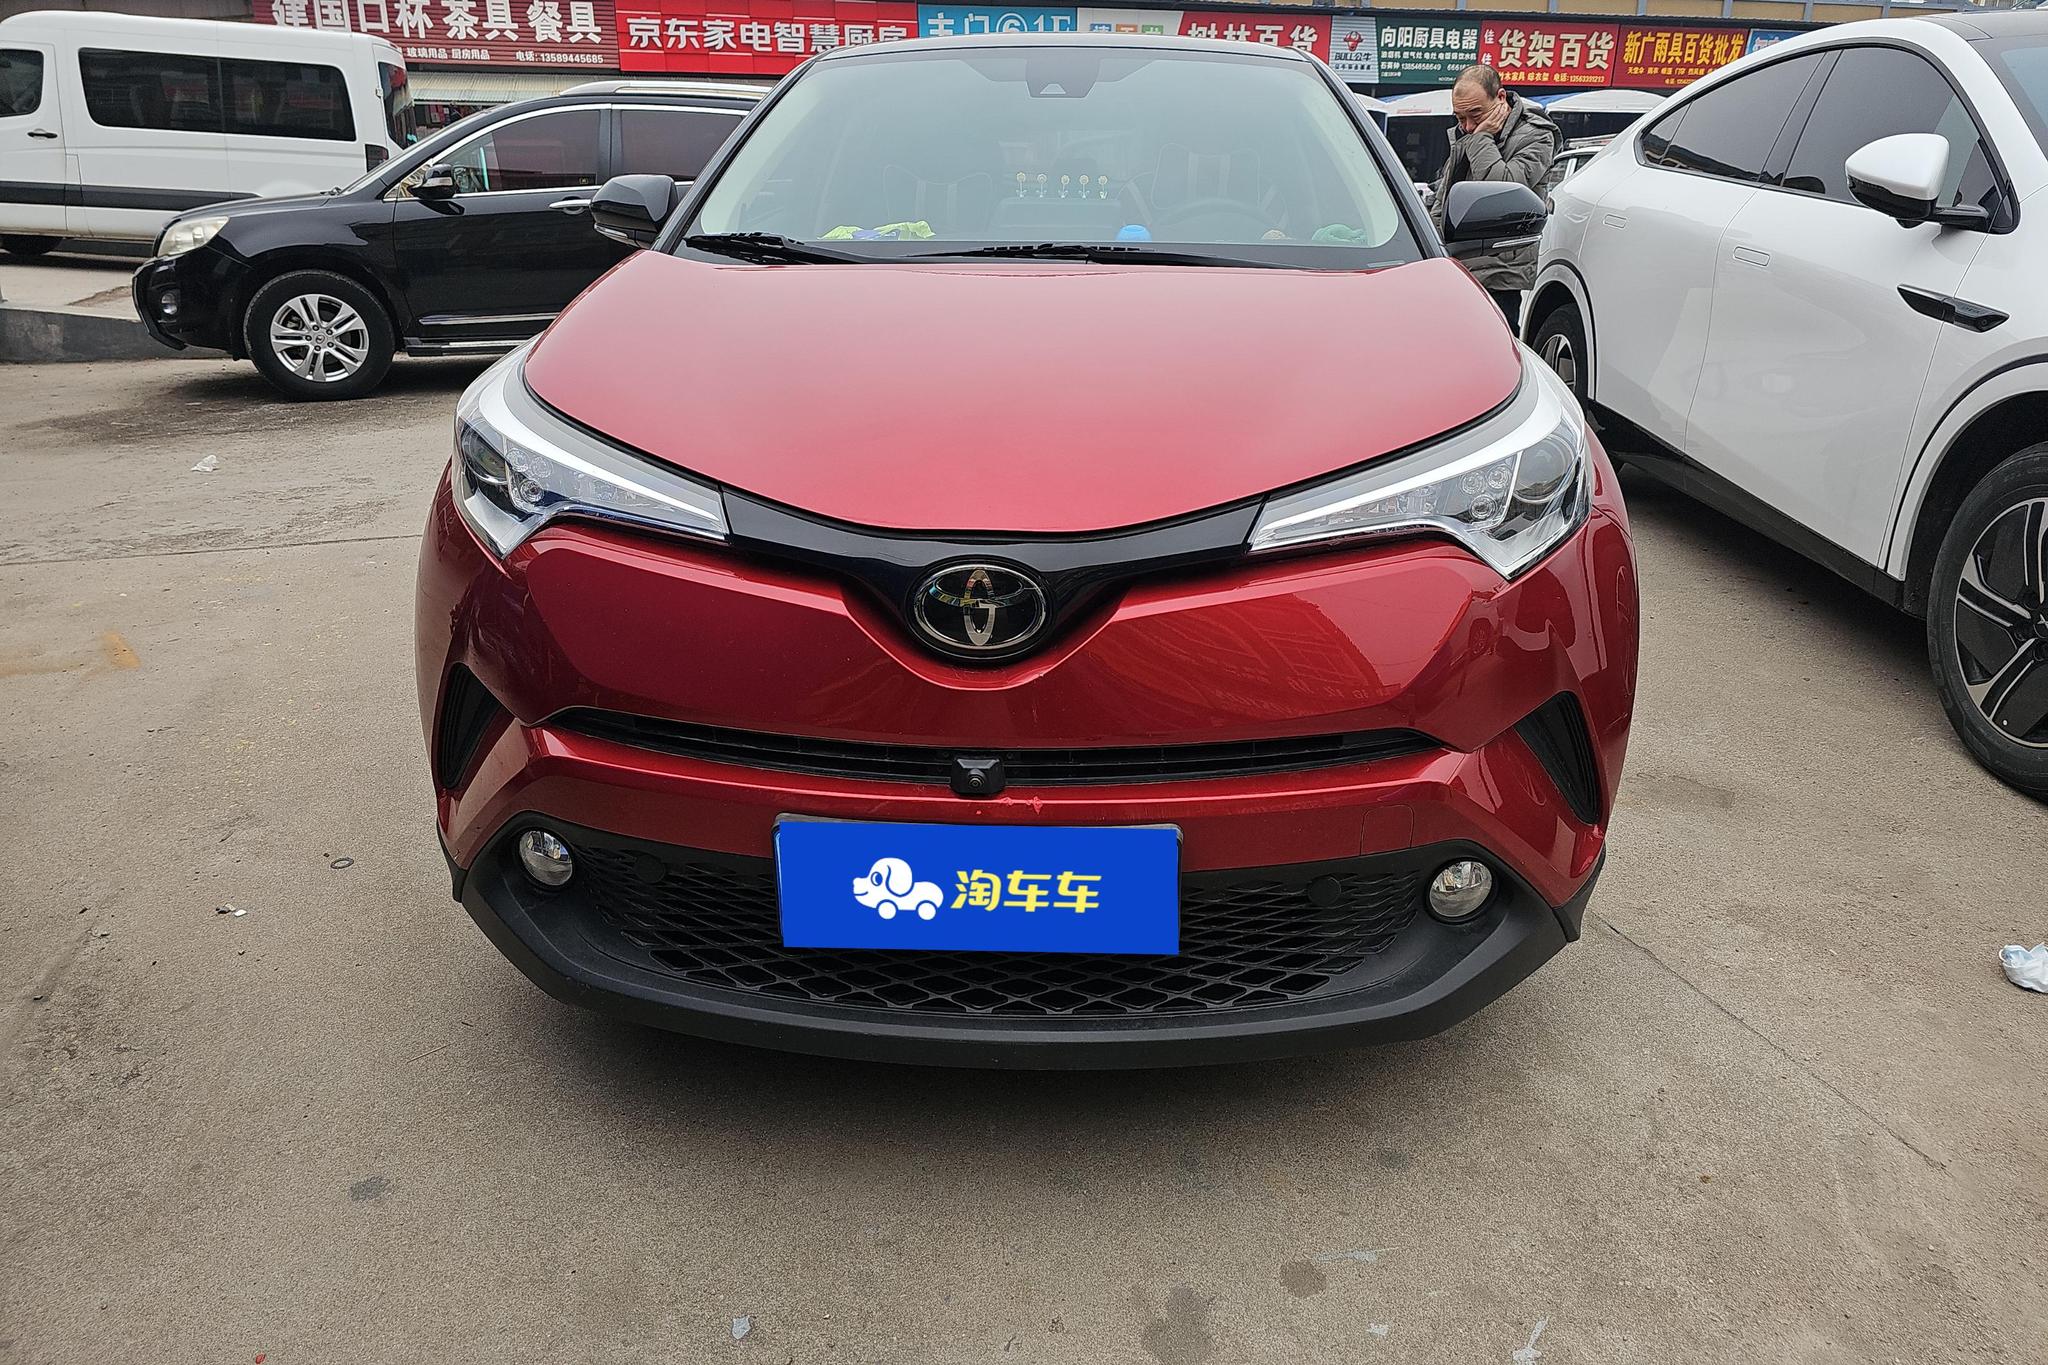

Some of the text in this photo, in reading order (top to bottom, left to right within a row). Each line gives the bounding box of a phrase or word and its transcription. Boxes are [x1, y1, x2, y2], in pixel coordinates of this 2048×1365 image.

[1380, 25, 1478, 50] 向阳厨具电器
[1498, 29, 1615, 70] 货架百货
[1622, 30, 1745, 65] 新广雨具百货批发
[407, 47, 448, 59] 玻璃用品
[452, 48, 490, 61] 厨房用品
